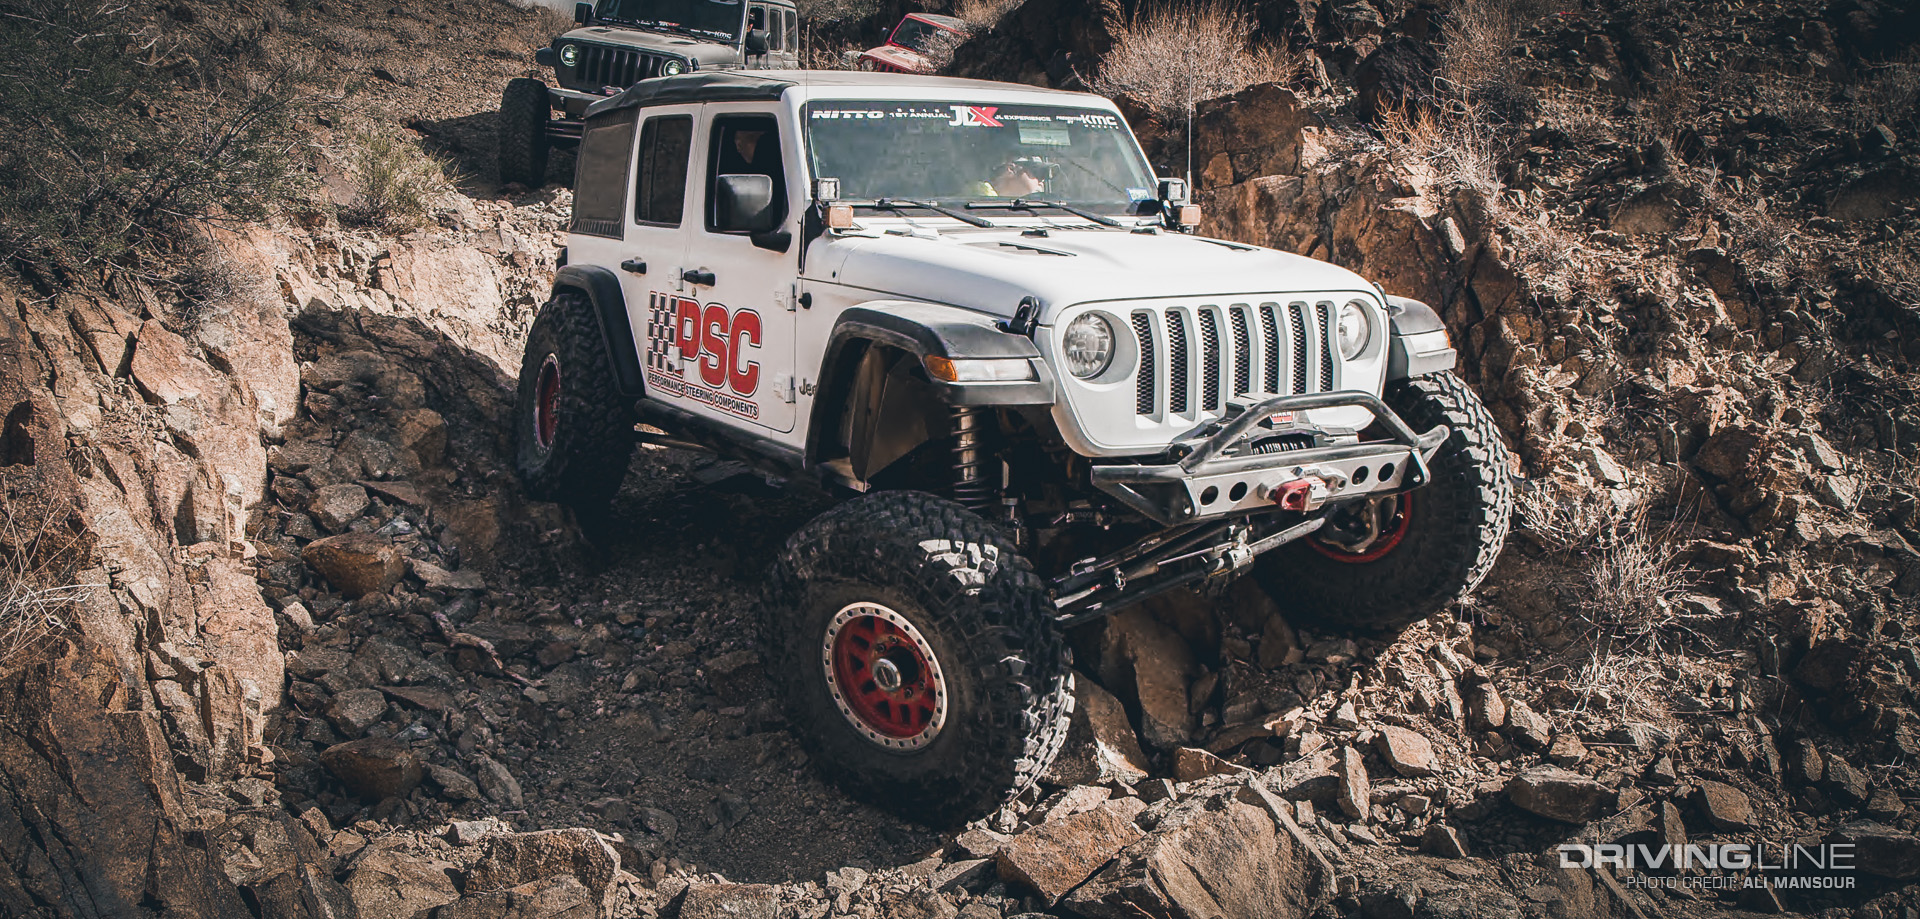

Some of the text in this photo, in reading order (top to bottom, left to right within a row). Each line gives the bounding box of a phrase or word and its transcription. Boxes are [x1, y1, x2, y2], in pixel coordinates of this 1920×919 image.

[811, 110, 884, 119] NITTO
[1080, 114, 1118, 126] KMC
[677, 296, 762, 397] PSC
[648, 372, 758, 417] PERFORMANCE STEERING COMPONENTS
[799, 377, 816, 397] Jee
